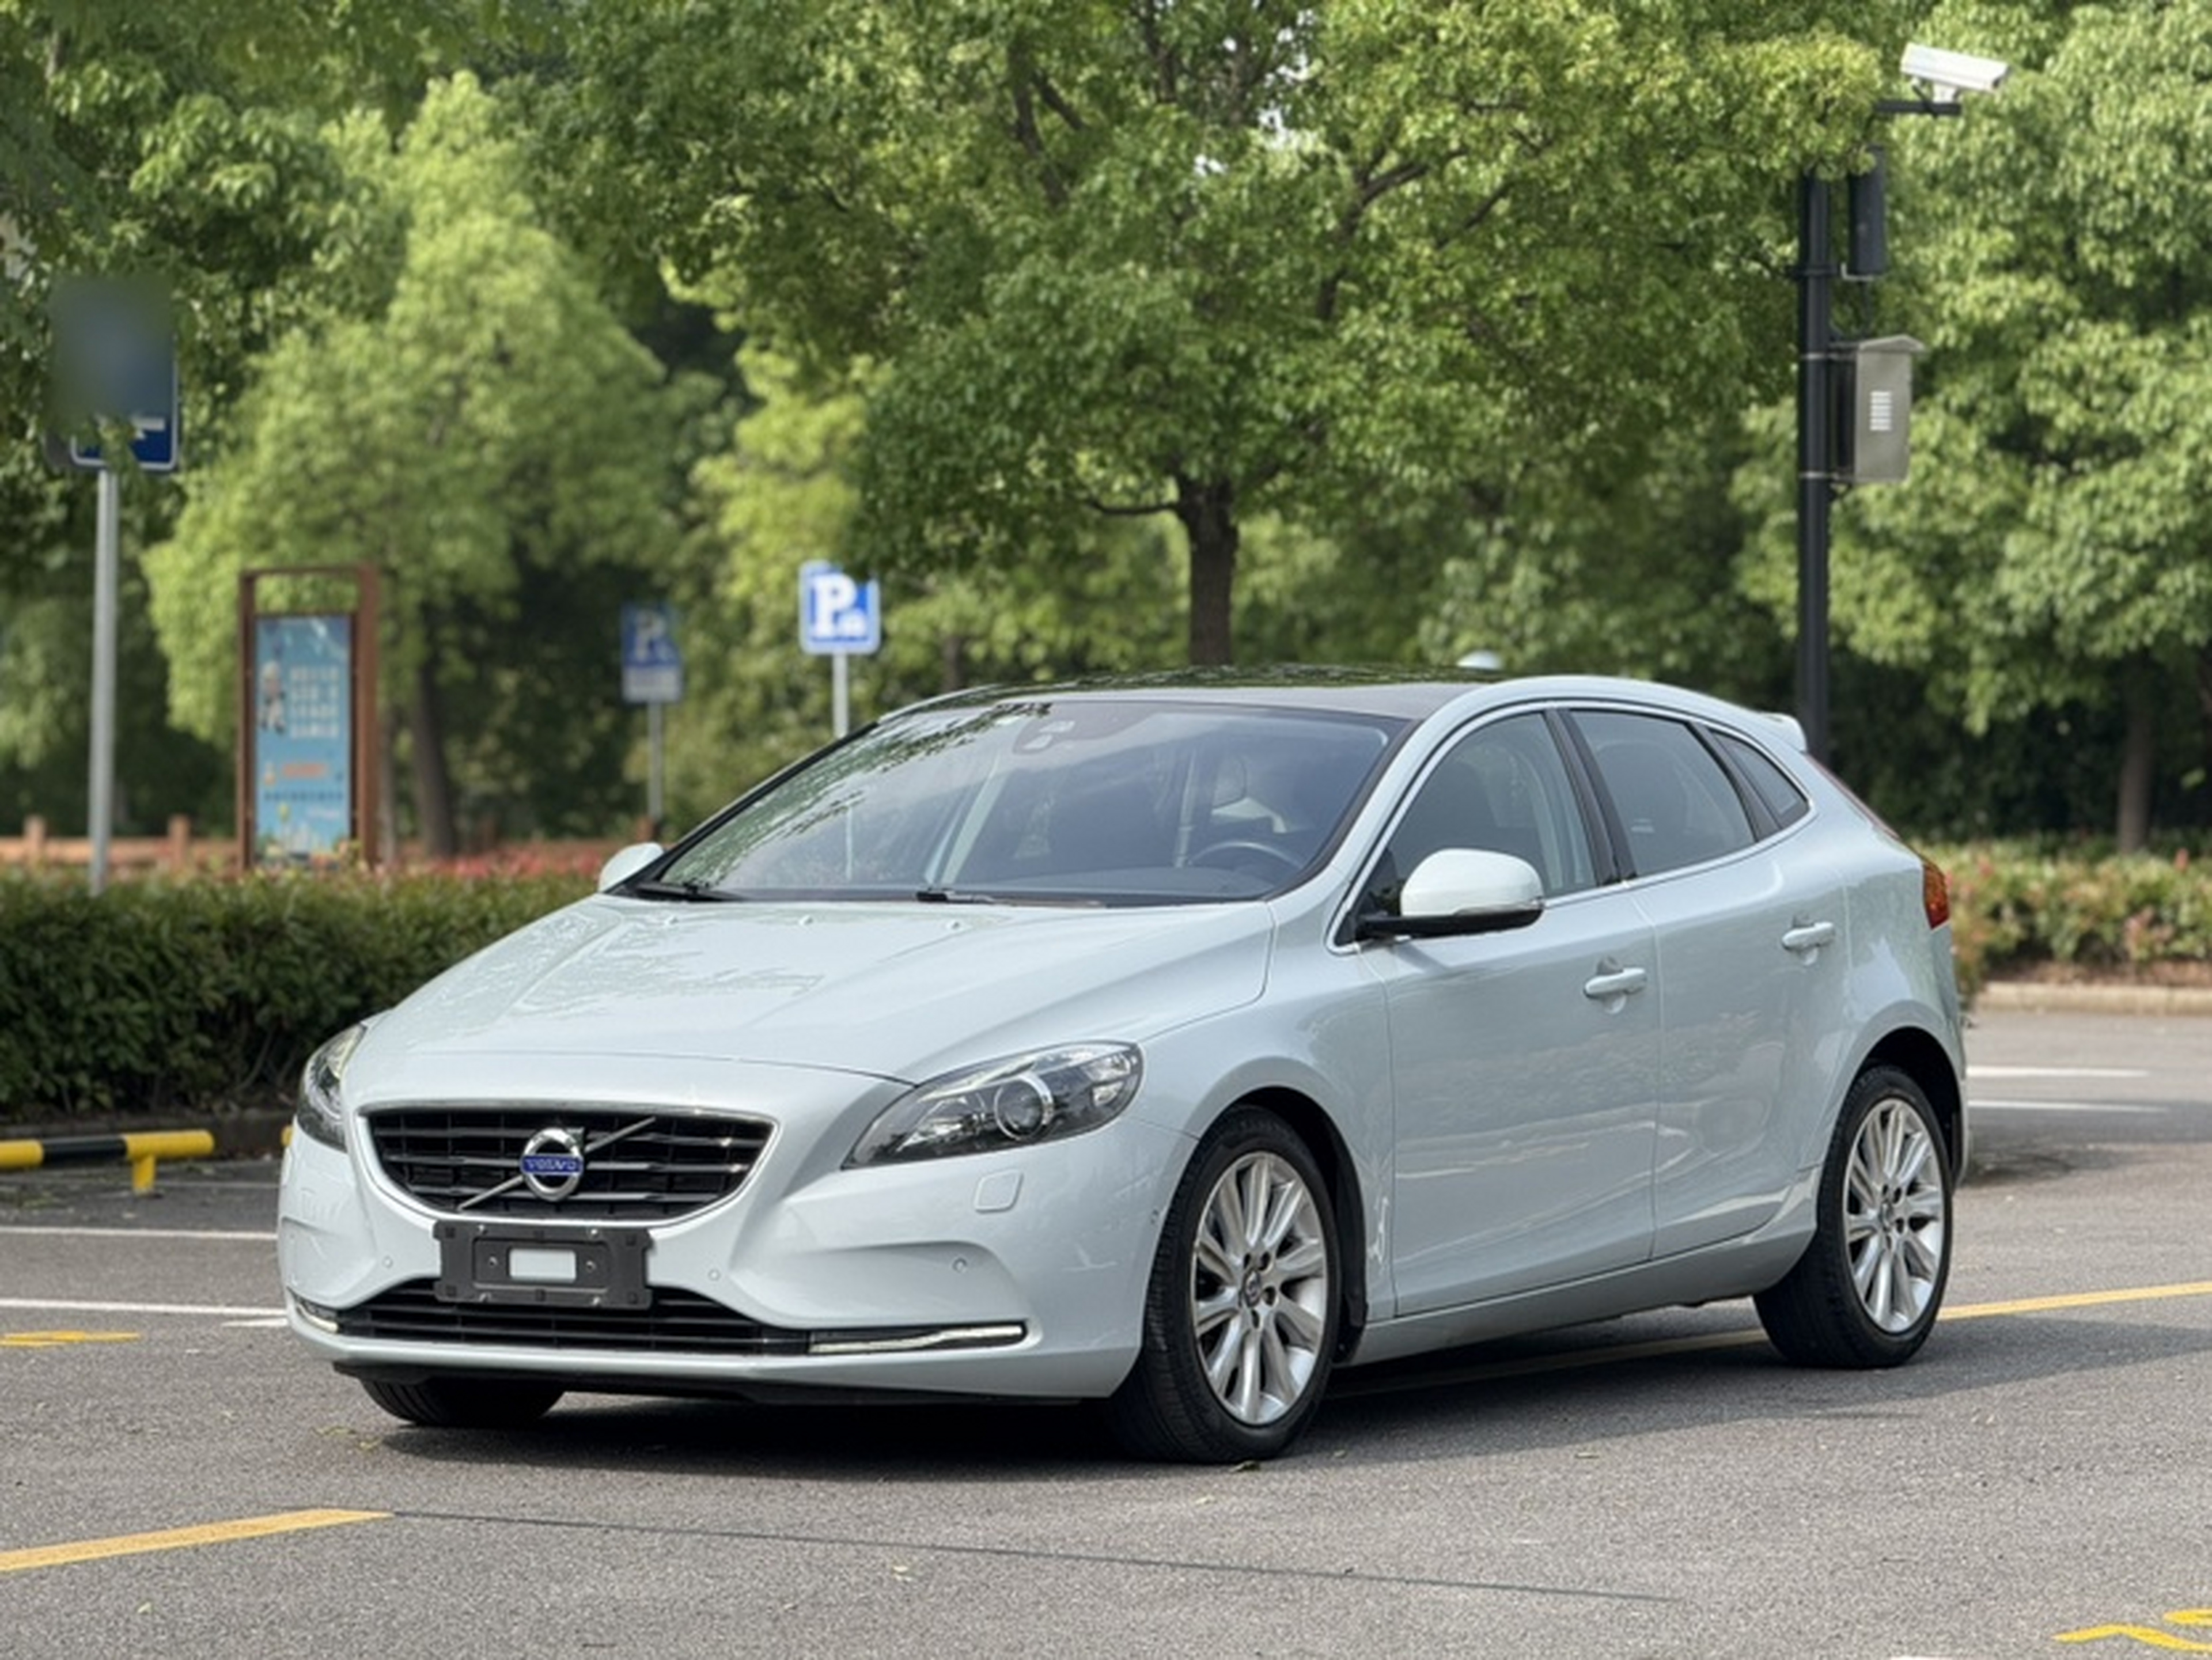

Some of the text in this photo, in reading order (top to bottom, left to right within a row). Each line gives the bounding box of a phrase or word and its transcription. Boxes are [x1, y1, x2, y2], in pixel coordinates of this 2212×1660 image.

[814, 575, 857, 637] P
[635, 610, 666, 662] P
[524, 1158, 577, 1170] VOLVO
